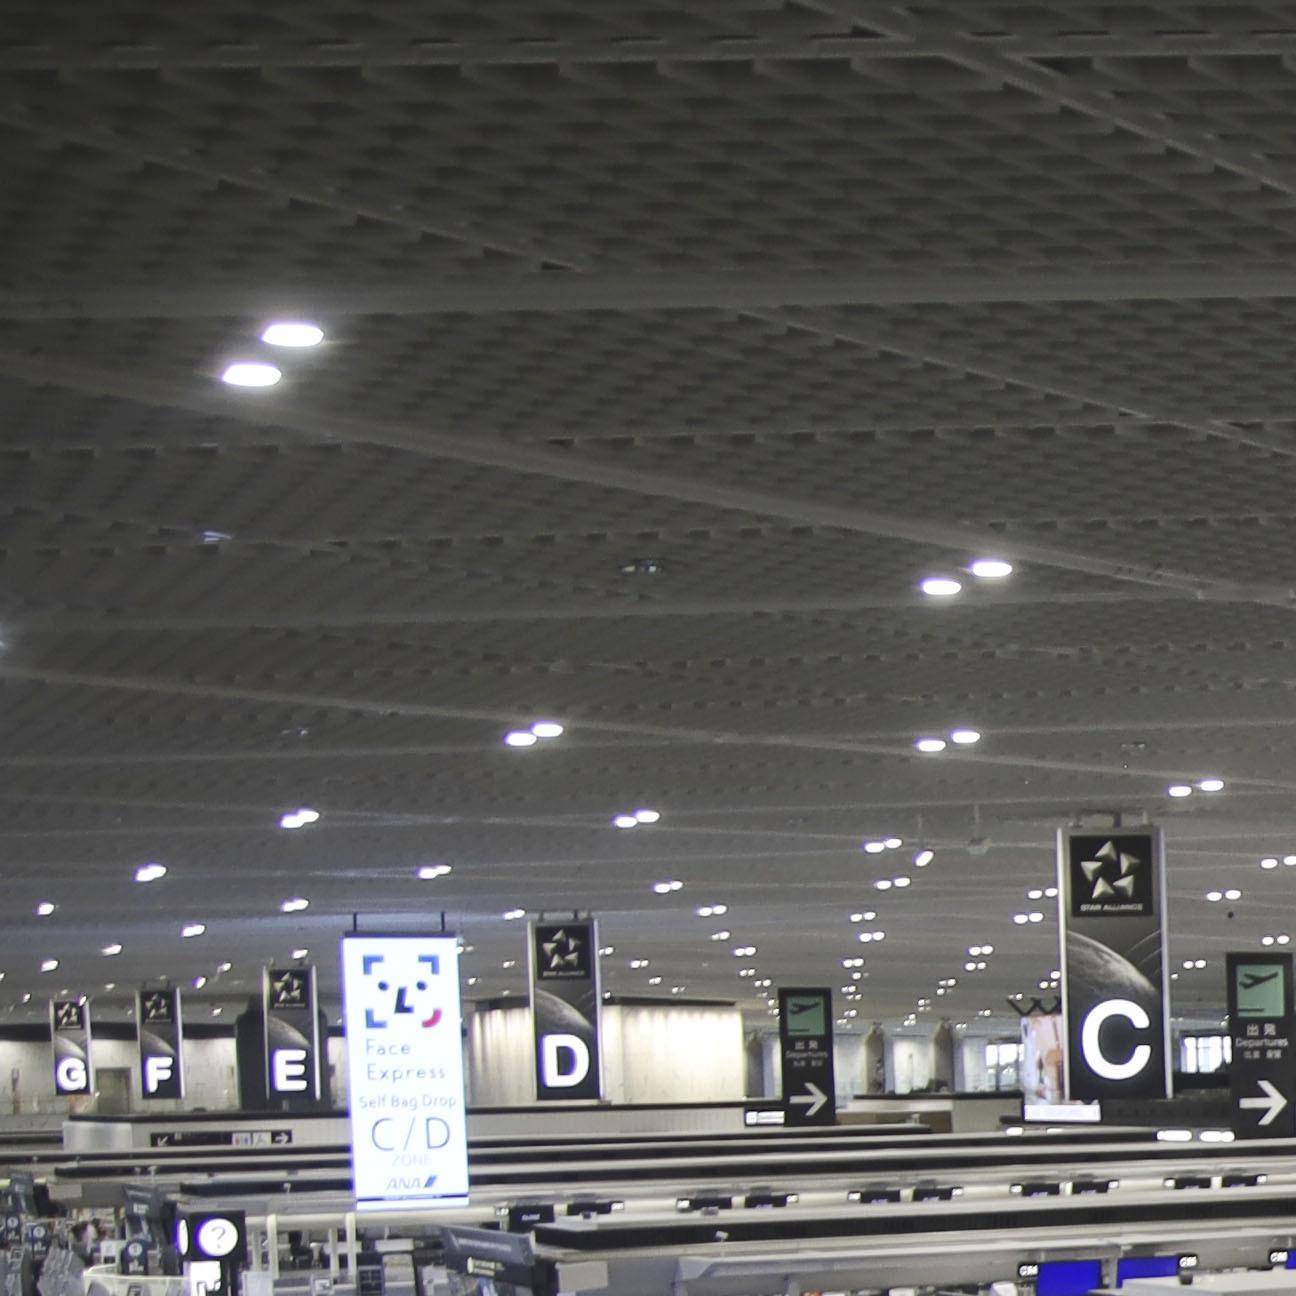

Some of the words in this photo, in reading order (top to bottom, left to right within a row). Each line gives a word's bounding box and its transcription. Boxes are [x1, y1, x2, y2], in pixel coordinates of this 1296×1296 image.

[366, 1039, 411, 1056] Face
[1081, 998, 1152, 1081] C
[1234, 1037, 1288, 1049] Departures
[274, 1049, 308, 1092] E
[542, 1033, 590, 1088] D
[56, 1056, 88, 1092] G
[146, 1056, 174, 1093] F
[366, 1063, 446, 1084] Express
[359, 1096, 386, 1109] Self
[391, 1095, 418, 1111] Bag
[423, 1094, 457, 1111] Drop
[391, 1153, 433, 1169] ZONE
[385, 1176, 422, 1191] ANA
